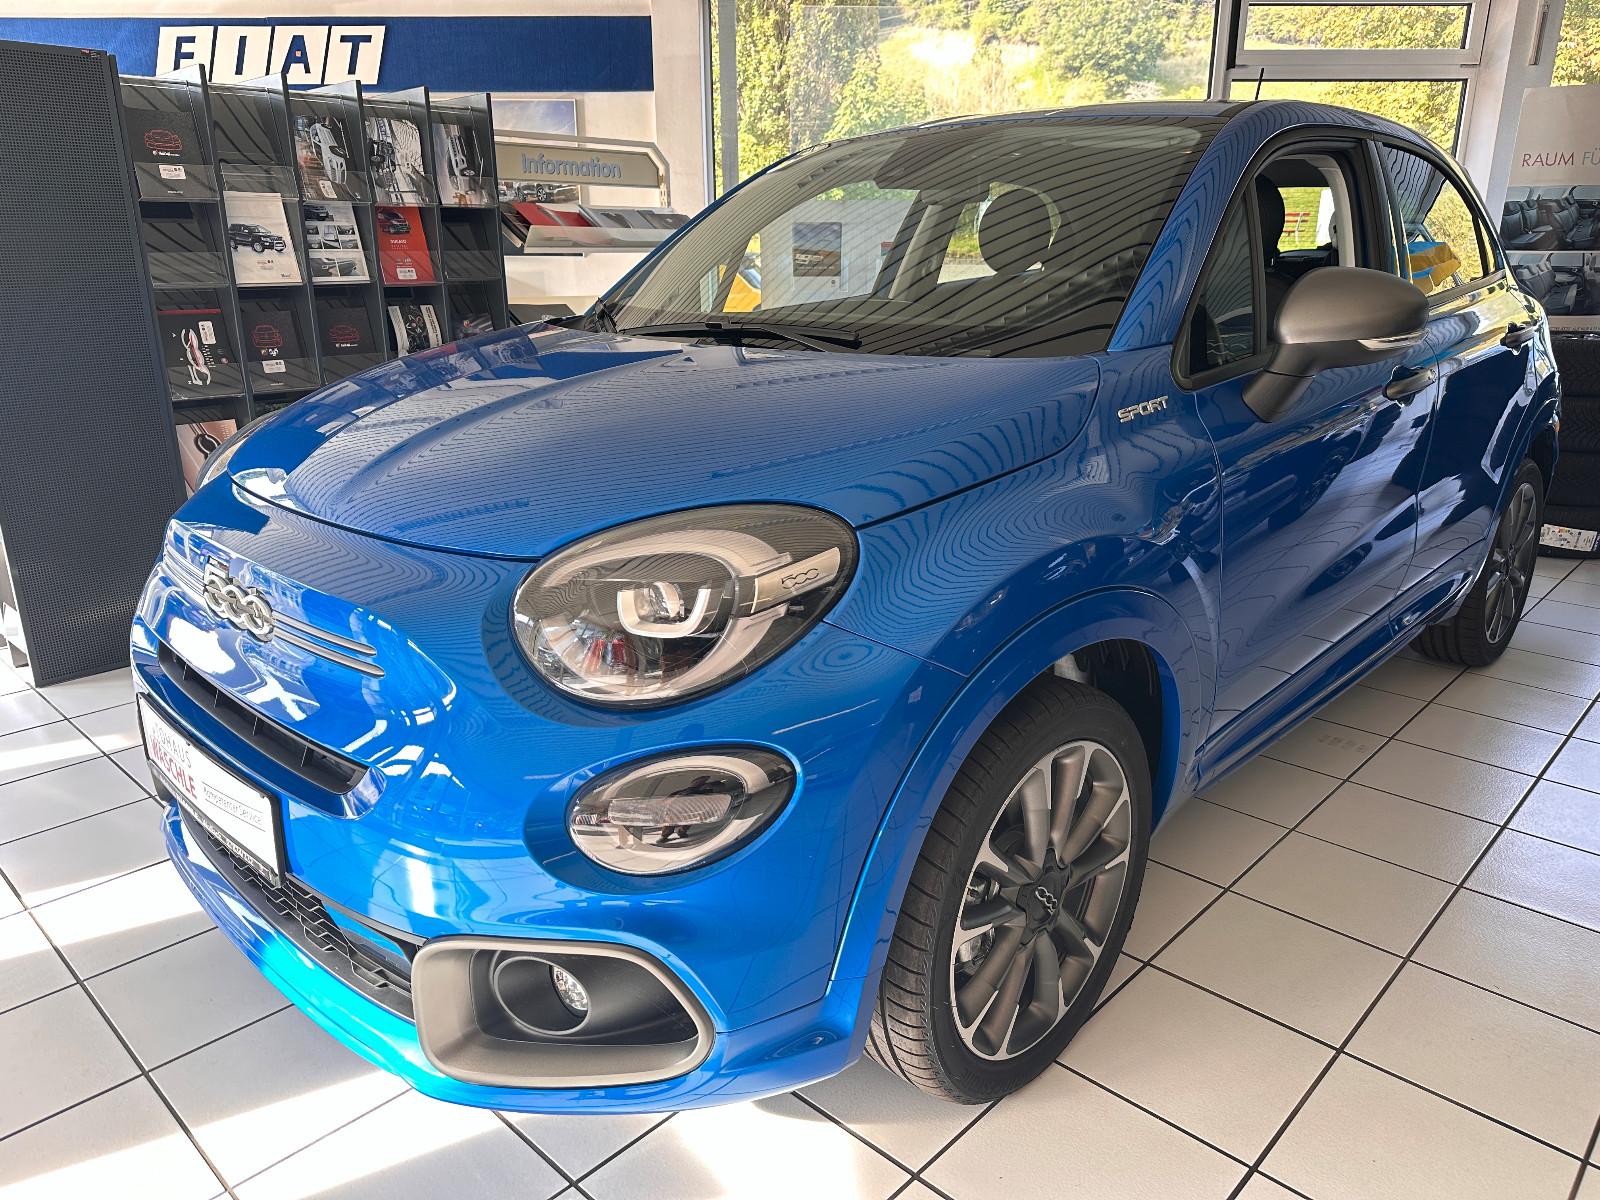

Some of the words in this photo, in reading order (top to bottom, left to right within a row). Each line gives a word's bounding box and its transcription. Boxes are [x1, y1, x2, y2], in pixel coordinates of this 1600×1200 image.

[173, 35, 373, 76] FIAT
[521, 153, 622, 179] Information
[1521, 151, 1575, 168] RAUM
[1117, 395, 1169, 423] SPORT
[781, 568, 820, 590] 500
[203, 555, 275, 642] 500
[148, 720, 192, 768] TOHAUS
